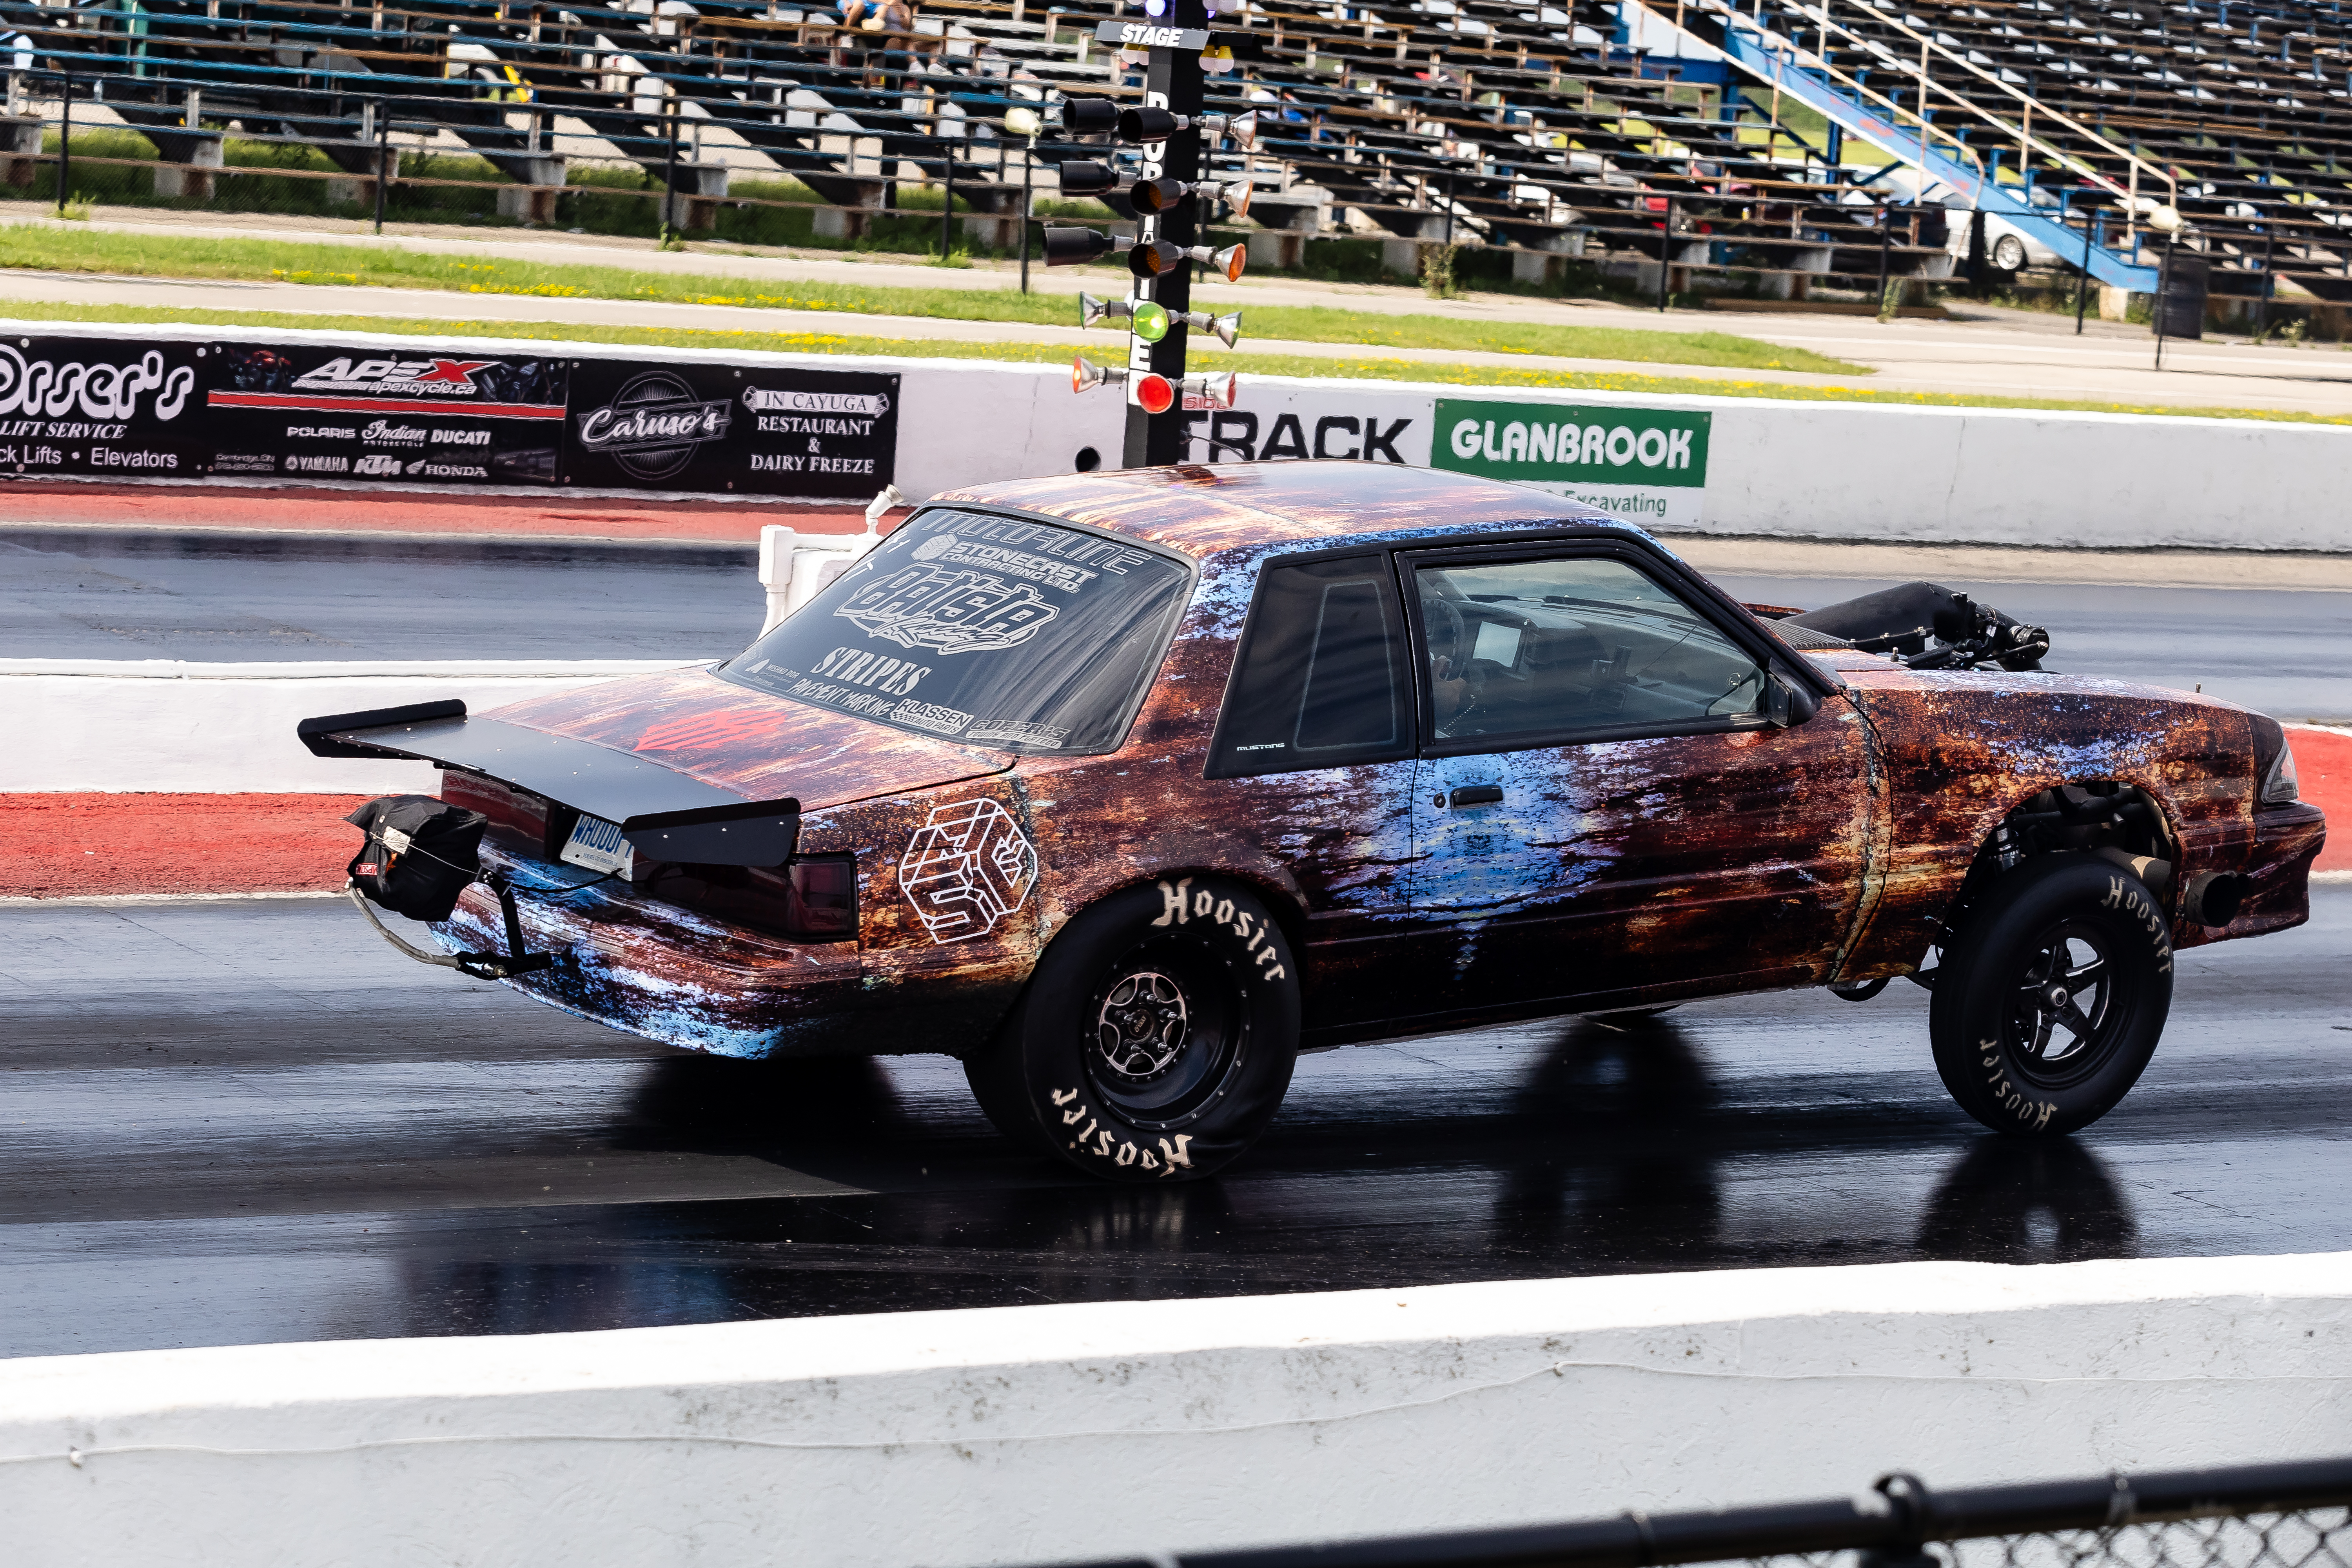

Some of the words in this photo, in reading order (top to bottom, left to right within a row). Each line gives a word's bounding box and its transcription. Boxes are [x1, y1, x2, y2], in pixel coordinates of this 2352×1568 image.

[1120, 24, 1184, 47] STAGE
[299, 356, 501, 385] APEX
[368, 381, 477, 396] apexcycle.ca
[764, 392, 784, 407] IN
[792, 394, 867, 411] CAYUGA
[0, 421, 46, 436] LIFT
[45, 422, 127, 439] SERVICE
[286, 426, 356, 439] POLARIS
[361, 419, 428, 441] Indian
[431, 429, 492, 445] DUCATI
[582, 405, 730, 443] Caruso's
[757, 416, 875, 436] RESTAURANT
[24, 445, 62, 464] Lifts
[91, 447, 178, 468] Elevators
[807, 437, 821, 453] &
[1451, 419, 1694, 470] GLANBROOK
[299, 456, 348, 472] YAMAHA
[353, 455, 403, 475] KTM
[425, 464, 488, 477] HONDA
[751, 453, 806, 470] DAIRY
[809, 456, 875, 474] FREEZE
[921, 512, 1154, 575] MOTORLINE
[939, 552, 1047, 581] CONTRACTING
[1045, 573, 1080, 594] LTD.
[948, 541, 1099, 583] STONECAST
[765, 663, 789, 675] MISHKO
[785, 670, 800, 679] DDR
[810, 646, 933, 696] STRIPES
[786, 678, 851, 704] PAVEMENT
[842, 691, 895, 717] MARKING
[897, 700, 973, 727] KLASSEN
[915, 717, 936, 729] AUTO
[935, 721, 960, 733] PARTS
[1237, 743, 1285, 751] MUSTANG
[1151, 877, 1285, 981] Hoosier
[2100, 875, 2172, 973] Hoosier
[1979, 1038, 2058, 1131] Hoosier
[1051, 1087, 1195, 1177] Hoosier
